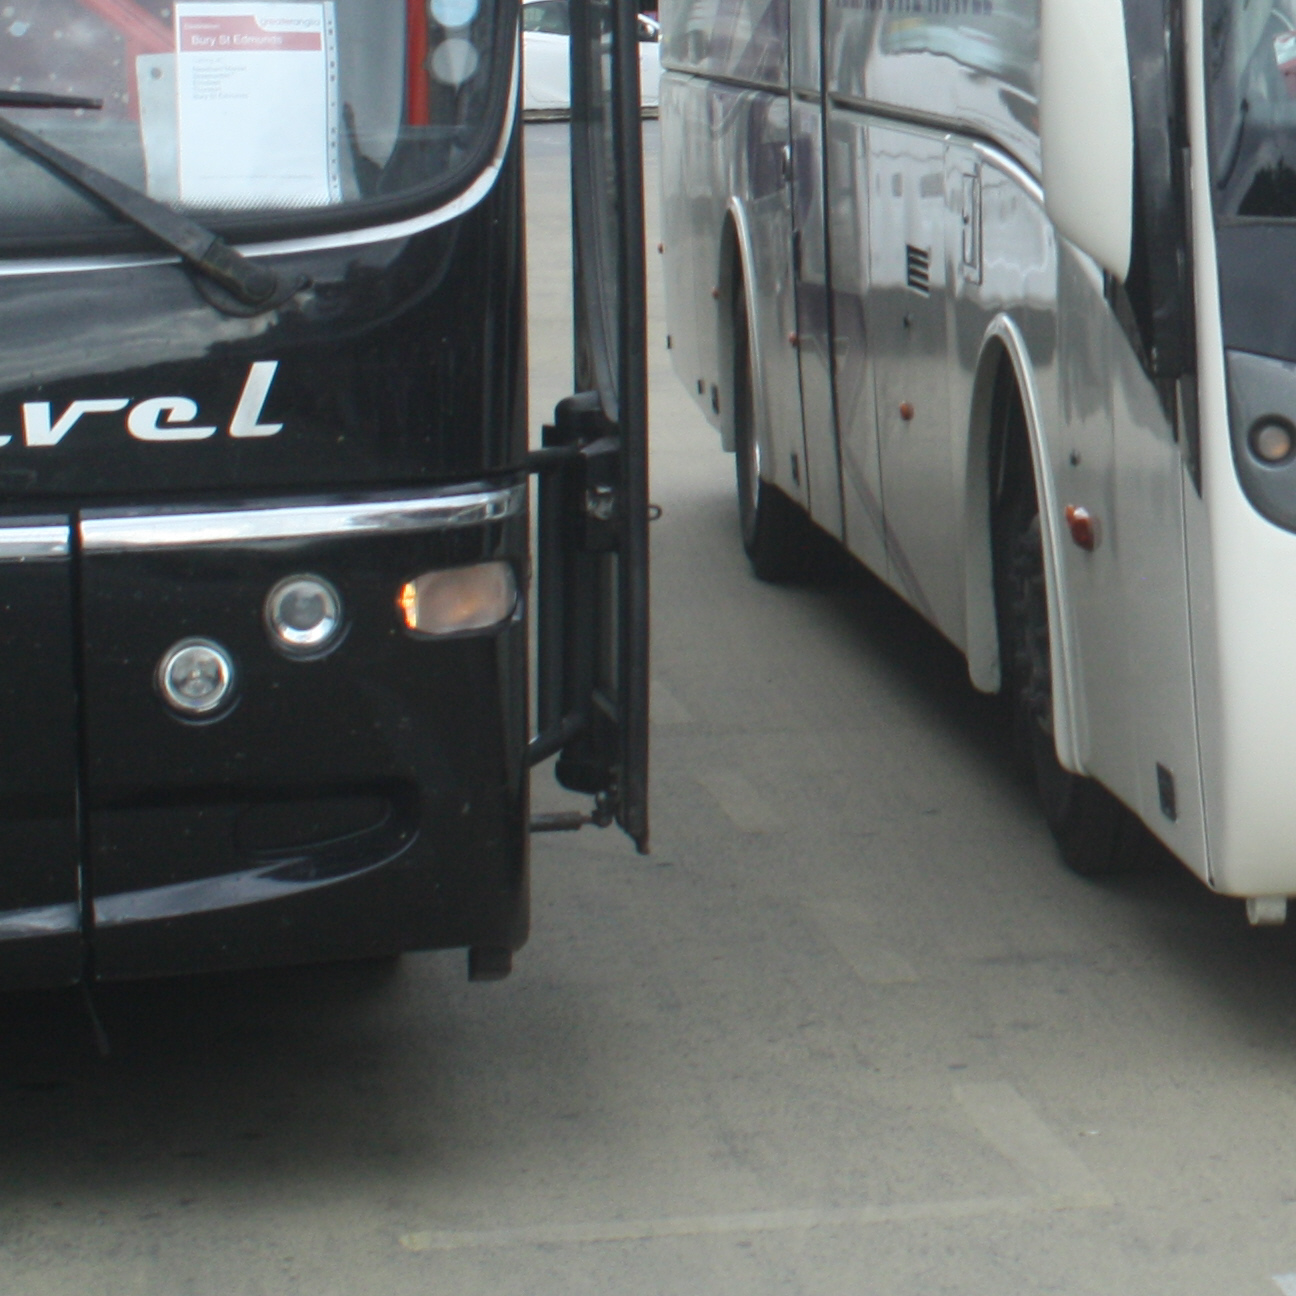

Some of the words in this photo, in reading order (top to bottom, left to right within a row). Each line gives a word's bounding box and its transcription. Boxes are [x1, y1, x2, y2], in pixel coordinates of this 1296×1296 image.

[191, 35, 216, 46] Bury
[219, 35, 231, 45] St
[233, 34, 283, 45] Edmunds
[0, 360, 284, 447] vel
